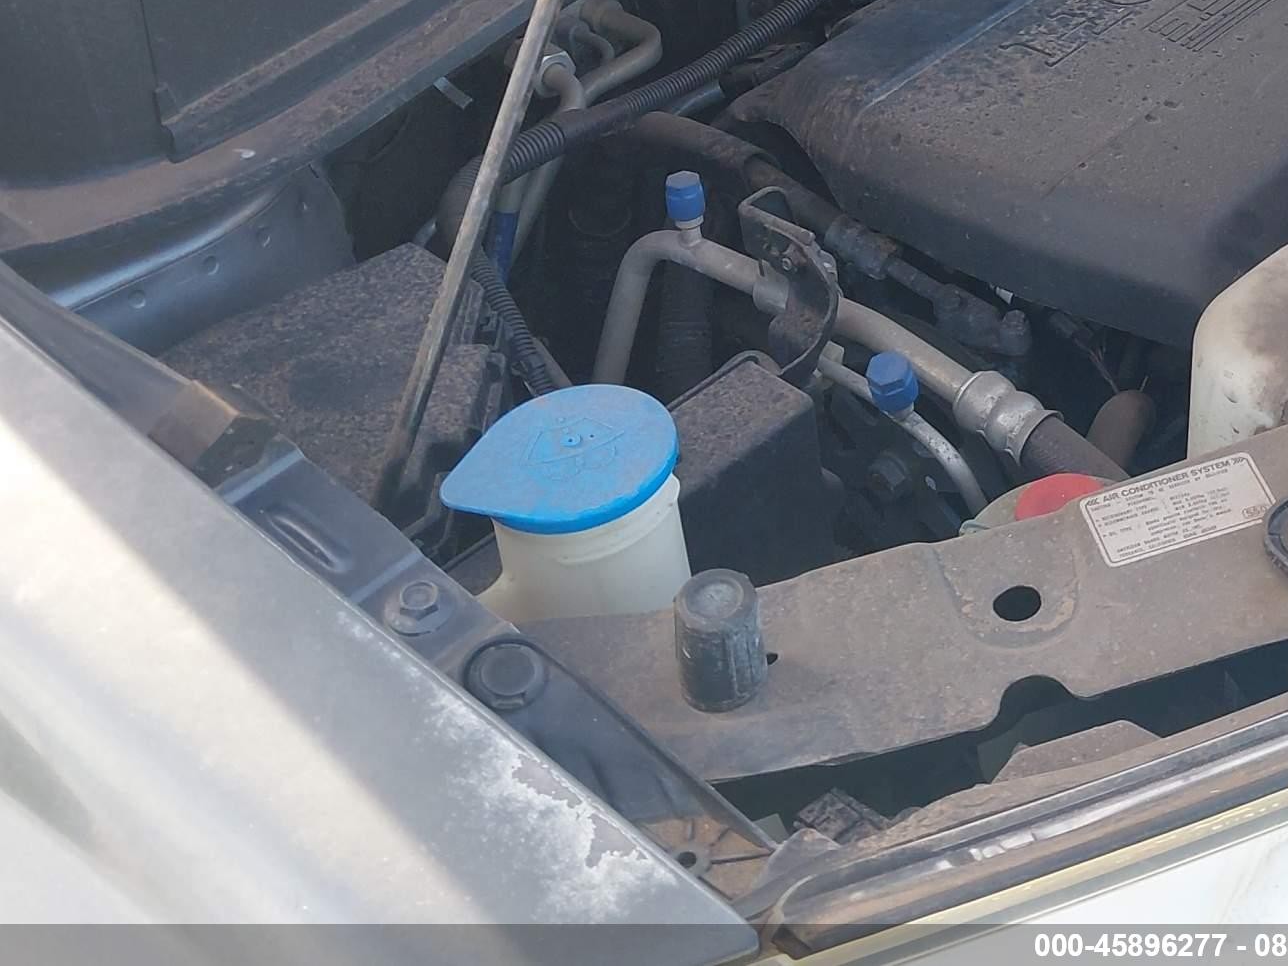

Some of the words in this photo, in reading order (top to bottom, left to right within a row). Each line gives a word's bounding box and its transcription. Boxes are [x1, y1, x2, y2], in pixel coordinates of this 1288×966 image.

[1102, 491, 1120, 505] AIR
[1121, 471, 1190, 498] CONDITIONER
[1190, 459, 1232, 477] SYSTEM
